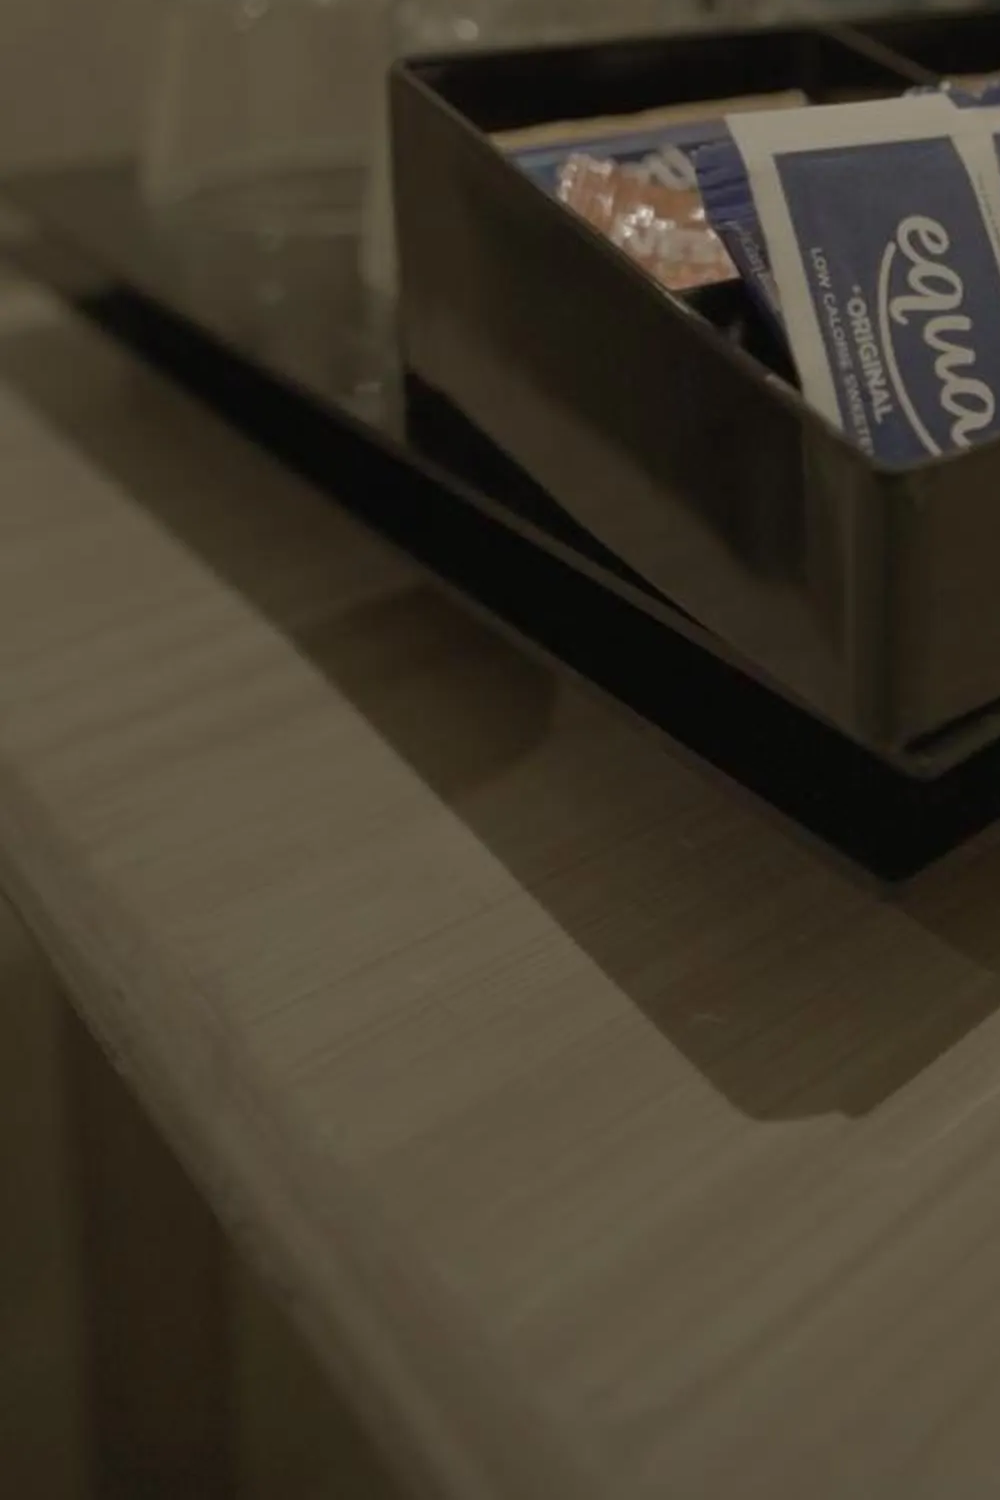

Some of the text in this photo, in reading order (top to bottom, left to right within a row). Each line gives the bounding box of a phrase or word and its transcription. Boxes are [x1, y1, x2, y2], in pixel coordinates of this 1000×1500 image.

[810, 247, 833, 289] LOW
[824, 292, 854, 374] CALORIE
[847, 297, 894, 426] ORIGINAL
